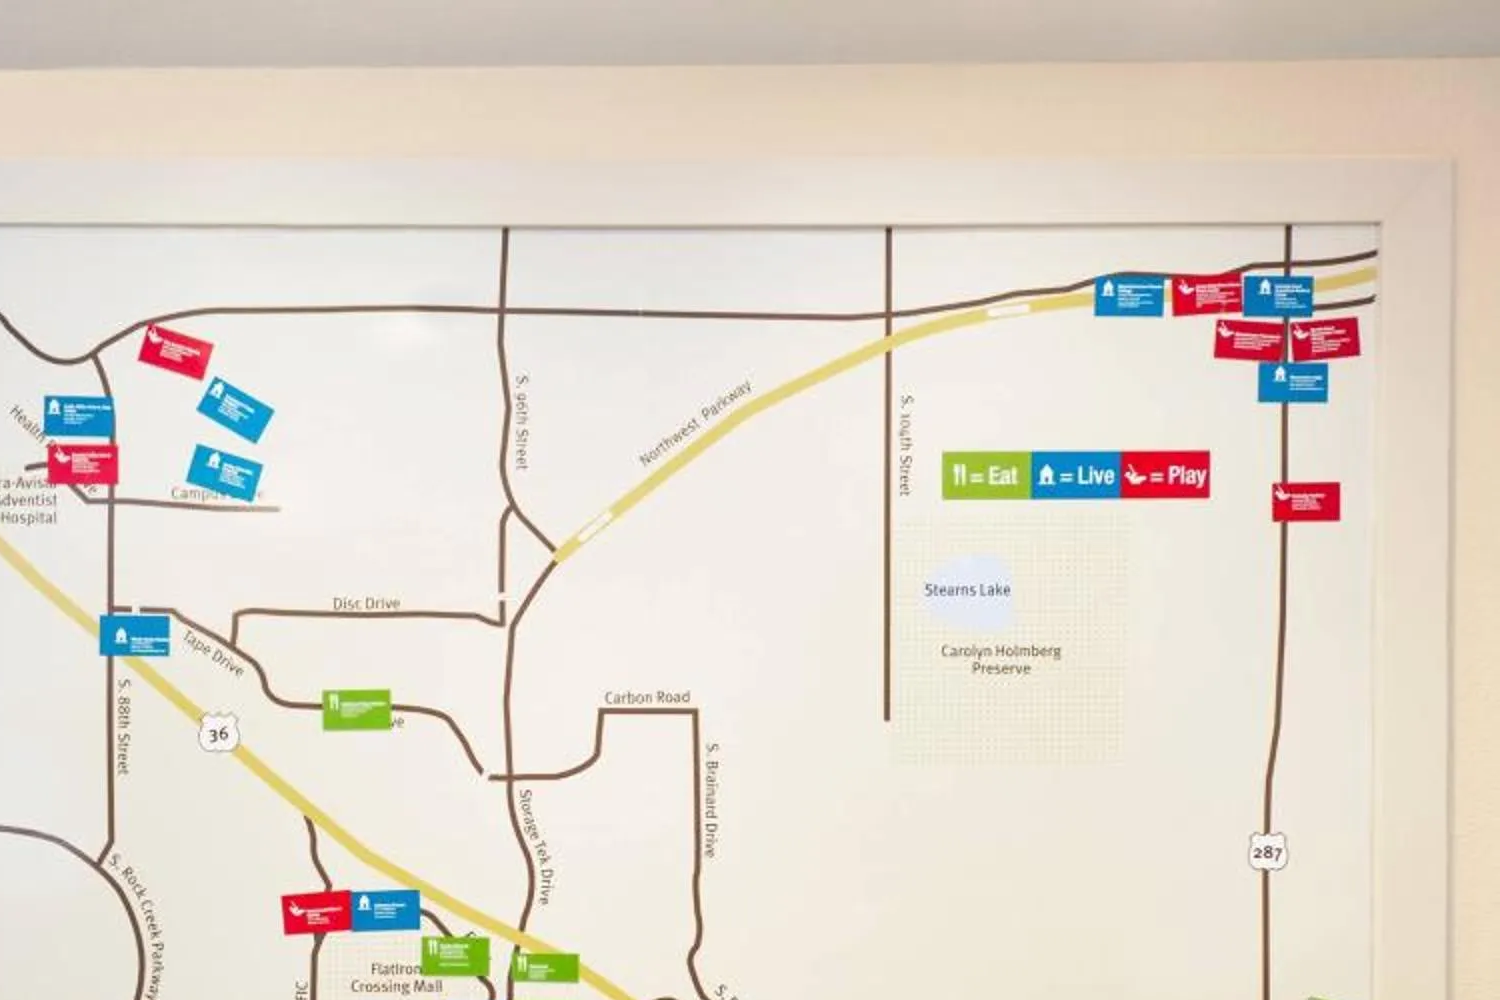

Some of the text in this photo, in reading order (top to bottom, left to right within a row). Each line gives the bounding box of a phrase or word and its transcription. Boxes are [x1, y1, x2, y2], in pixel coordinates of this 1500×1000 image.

[515, 375, 529, 389] S.
[900, 395, 914, 409] S.
[9, 404, 46, 443] Health
[639, 380, 753, 467] Northwest Parkway
[515, 428, 529, 470] Street
[900, 455, 913, 497] Street
[988, 464, 1019, 485] Eat
[1078, 464, 1115, 486] Live
[1168, 465, 1207, 491] Play
[1, 511, 57, 526] Hospital
[924, 583, 1011, 597] Stearns Lake
[333, 596, 400, 610] Disc Drive
[183, 629, 211, 659] Tape
[211, 650, 244, 679] Drive
[941, 644, 1062, 660] Carolyn Holmberg
[972, 662, 1032, 675] Preserve
[605, 690, 691, 705] Carbon Road
[117, 679, 132, 775] S. 88th Street
[209, 726, 230, 743] 36
[705, 743, 720, 859] S. Brainard Drive
[519, 790, 554, 906] Storage Tek Drive
[1254, 846, 1282, 861] 287
[108, 854, 121, 871] S.
[122, 866, 147, 900] Rock
[141, 900, 162, 940] Creek
[351, 980, 443, 995] Crossing Mall
[714, 983, 727, 1000] S.
